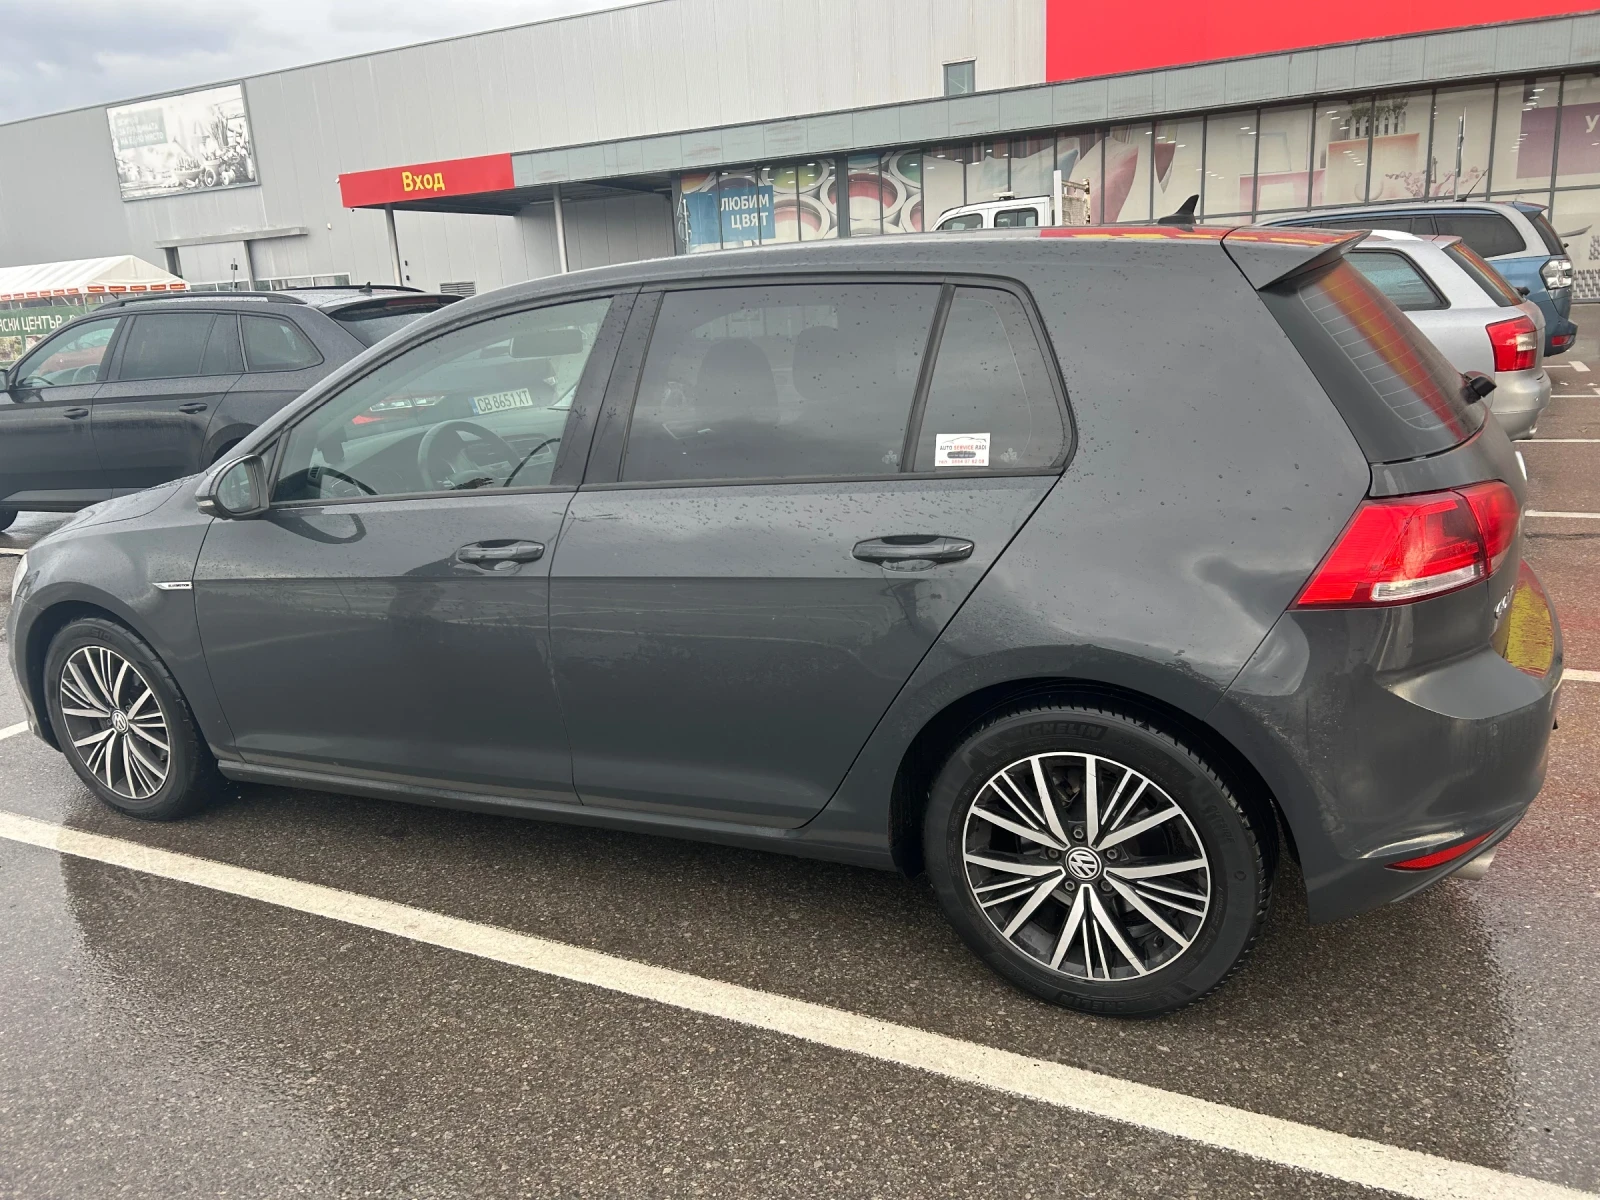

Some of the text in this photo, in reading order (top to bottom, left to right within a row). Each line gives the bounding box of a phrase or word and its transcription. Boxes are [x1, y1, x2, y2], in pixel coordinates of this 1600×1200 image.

[401, 171, 446, 192] Вход
[720, 193, 769, 212] ЛЮБИМ
[731, 212, 769, 230] ЦВЯТ
[20, 315, 63, 333] ЦЕНТЪР
